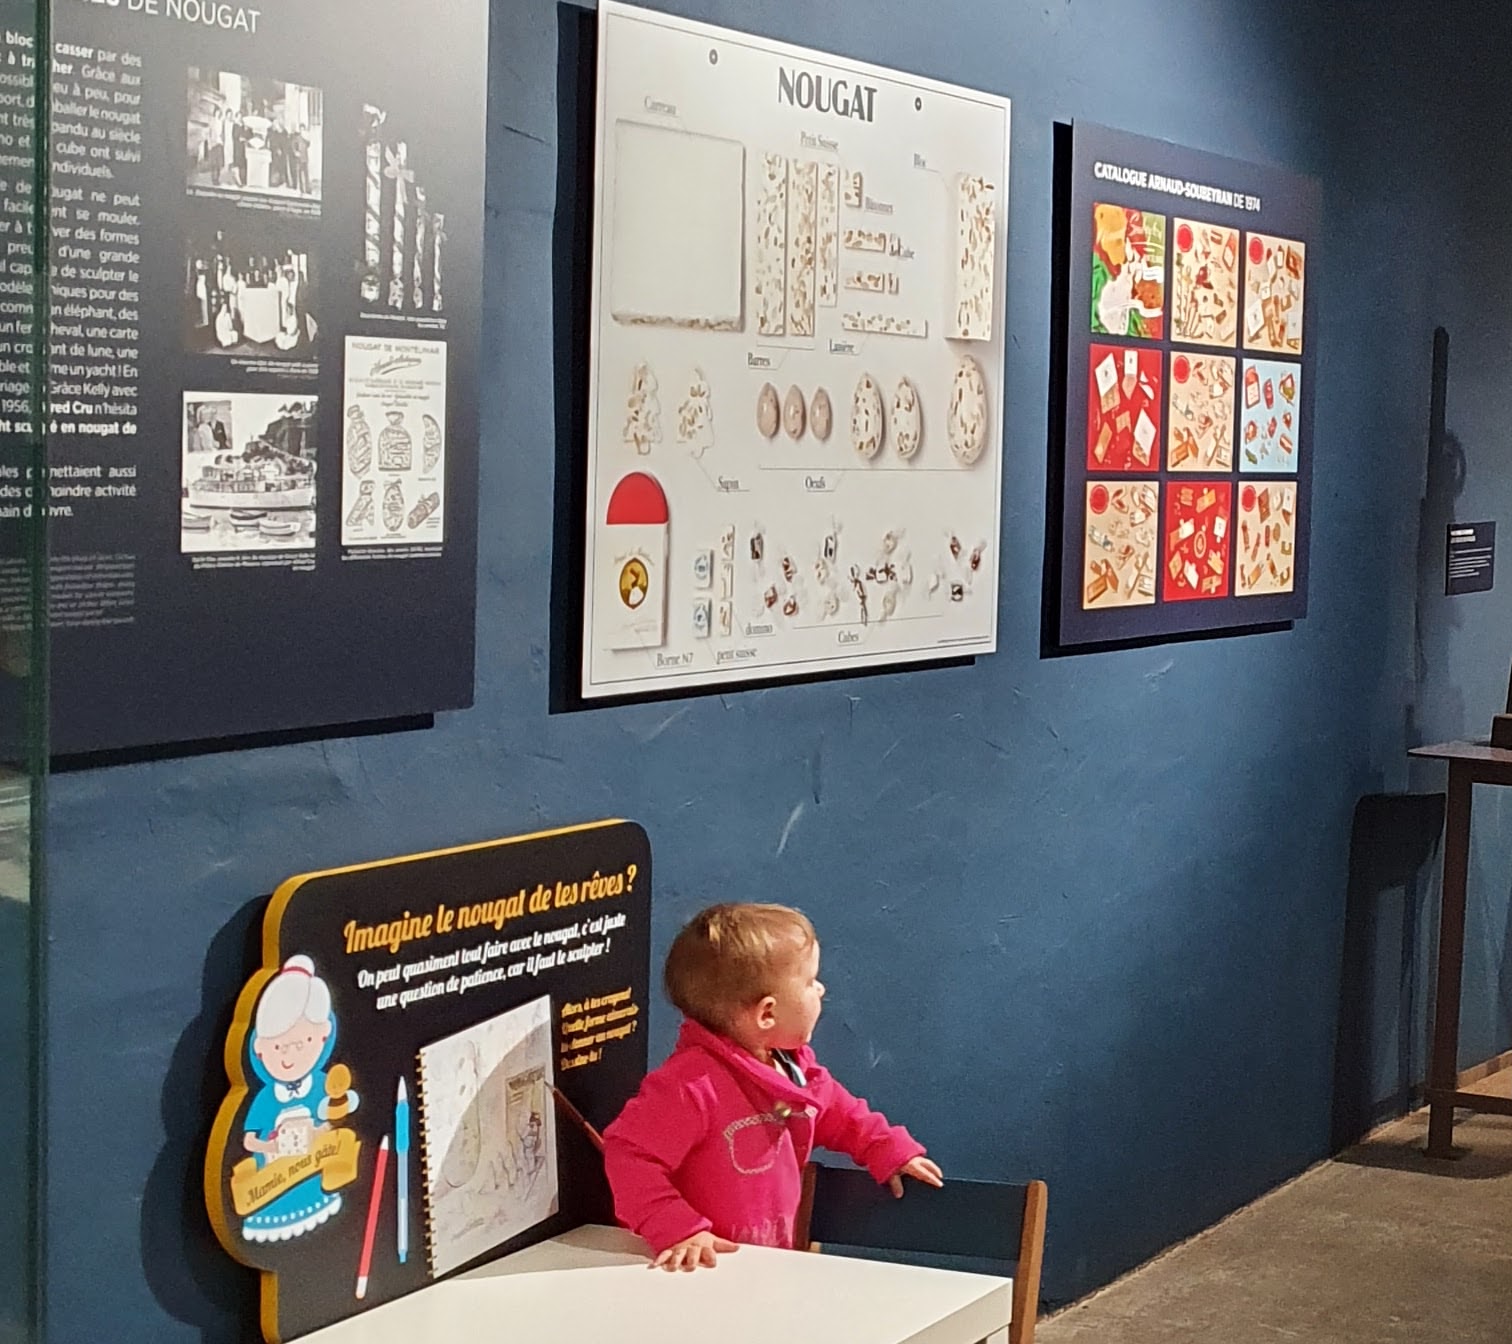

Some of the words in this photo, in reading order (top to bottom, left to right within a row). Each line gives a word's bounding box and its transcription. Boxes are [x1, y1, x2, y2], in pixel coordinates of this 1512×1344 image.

[55, 42, 94, 59] casser
[97, 50, 116, 63] par
[121, 52, 142, 68] des
[81, 63, 116, 83] Grâce
[0, 74, 34, 88] ossibl
[114, 91, 141, 106] pour
[778, 66, 878, 123] NOUGAT
[89, 105, 100, 119] le
[101, 107, 141, 126] nougat
[52, 120, 88, 137] pandu
[91, 126, 106, 139] au
[109, 127, 141, 144] siècle
[18, 135, 31, 148] et
[56, 141, 86, 155] cube
[90, 146, 111, 160] ont
[115, 149, 141, 163] suivi
[52, 159, 114, 179] ndividuels.
[16, 179, 32, 194] de
[91, 191, 107, 203] ne
[114, 193, 141, 207] peut
[1094, 161, 1148, 188] CATALOGUE
[1234, 193, 1245, 209] DE
[76, 208, 90, 221] se
[75, 227, 96, 241] des
[99, 228, 140, 245] formes
[58, 245, 92, 260] d'une
[99, 250, 140, 264] grande
[60, 264, 77, 278] de
[80, 267, 126, 282] sculpter
[129, 270, 139, 283] le
[89, 288, 116, 301] pour
[118, 289, 139, 303] des
[118, 307, 139, 321] des
[16, 320, 32, 334] fer
[51, 321, 84, 338] heval,
[86, 327, 108, 339] une
[109, 326, 139, 340] carte
[70, 344, 85, 356] de
[117, 348, 139, 359] une
[70, 364, 85, 375] un
[86, 364, 116, 378] yacht
[123, 364, 138, 377] En
[83, 382, 111, 398] Kelly
[112, 385, 138, 397] avec
[72, 401, 93, 415] Cru
[61, 422, 76, 433] en
[78, 421, 119, 436] nougat
[122, 421, 138, 435] de
[108, 464, 137, 478] aussi
[94, 484, 137, 498] activité
[838, 630, 860, 644] Cubes
[343, 909, 434, 954] Imagine
[436, 904, 455, 933] le
[457, 888, 526, 931] nougat
[529, 883, 553, 913] de
[555, 880, 579, 909] tes
[580, 870, 625, 904] rêves
[626, 864, 638, 894] ?
[357, 969, 375, 989] On
[375, 963, 401, 990] peut
[402, 949, 460, 984] quasiment
[461, 945, 483, 964] tout
[481, 939, 509, 966] faire
[509, 937, 532, 954] avec
[533, 930, 543, 947] le
[543, 921, 582, 947] nougat,
[376, 991, 399, 1011] une
[400, 978, 445, 1009] question
[446, 975, 460, 994] de
[460, 964, 507, 994] patience,
[507, 962, 525, 978] car
[534, 953, 556, 977] faut
[557, 949, 567, 966] le
[567, 941, 604, 964] sculpter
[246, 1172, 287, 1207] Mamie,
[287, 1154, 313, 1178] nous
